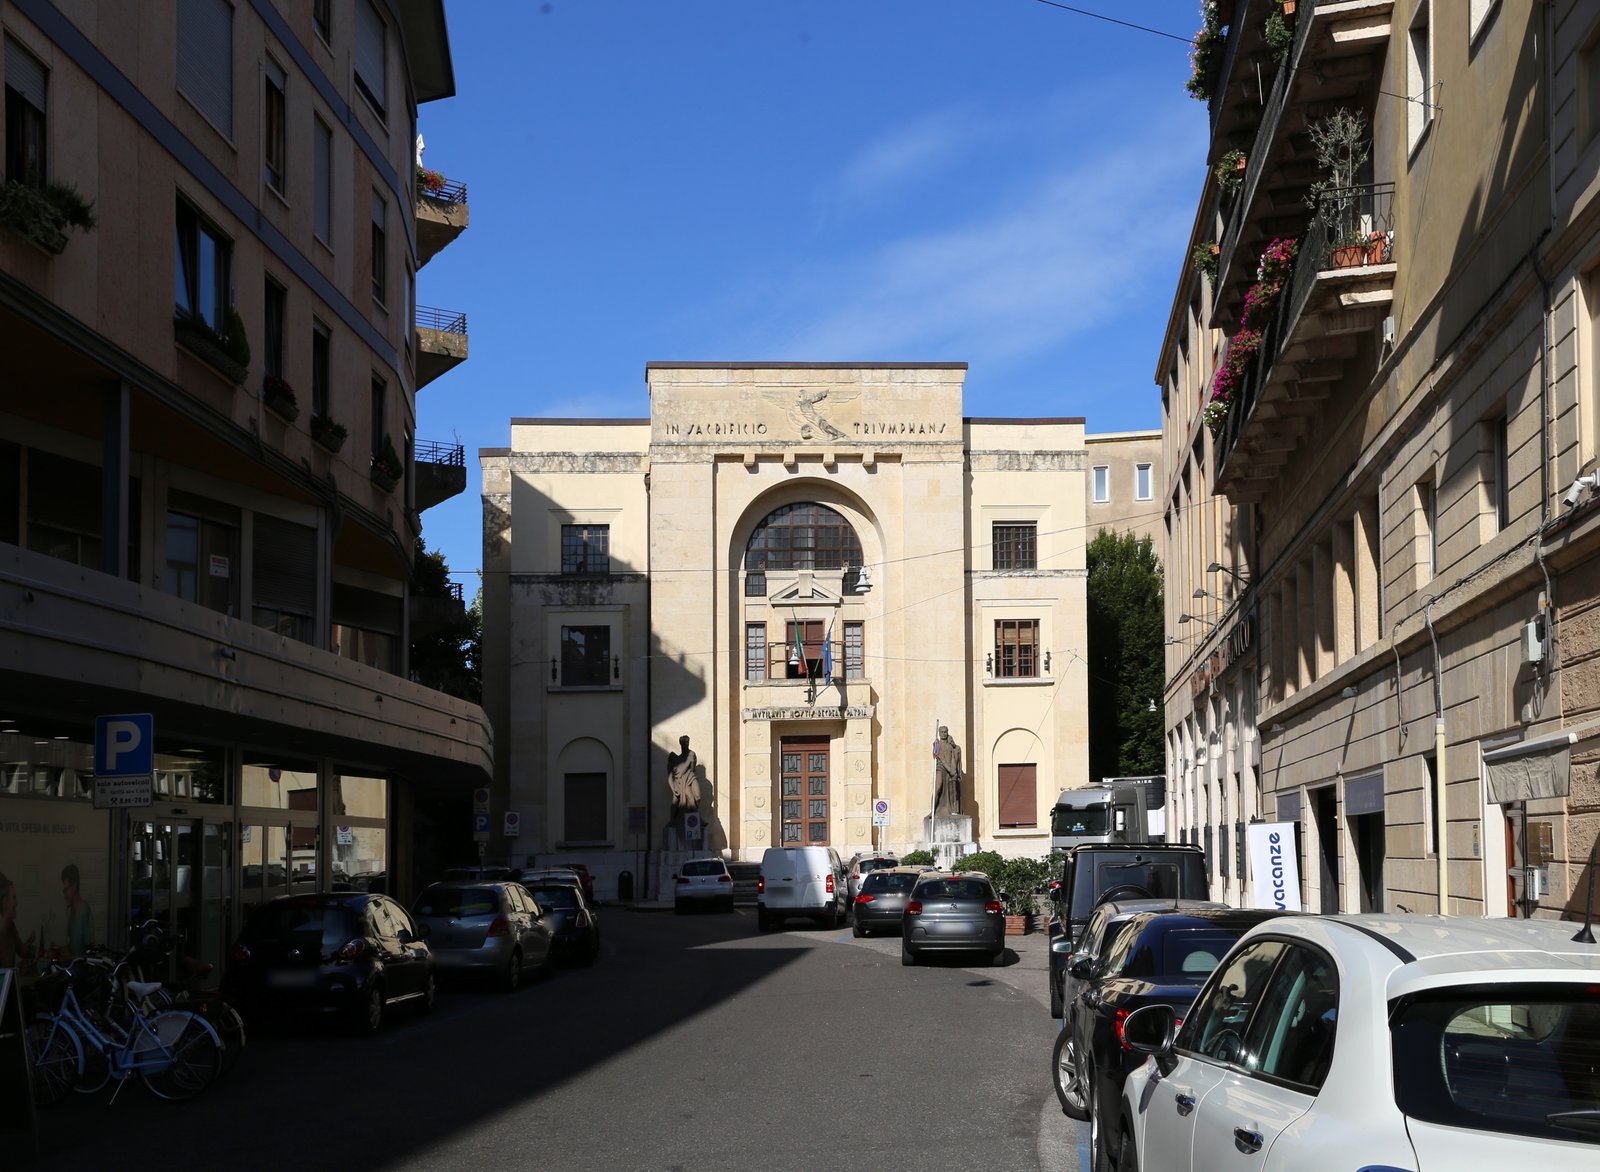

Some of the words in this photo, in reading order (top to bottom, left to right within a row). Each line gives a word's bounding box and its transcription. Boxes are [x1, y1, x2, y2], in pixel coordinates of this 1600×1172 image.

[666, 423, 680, 435] IN
[688, 423, 768, 435] SACRIFICIO
[853, 422, 946, 435] TRIVMPHANS
[106, 720, 142, 770] P
[476, 816, 487, 831] P
[1269, 832, 1286, 911] vacanze
